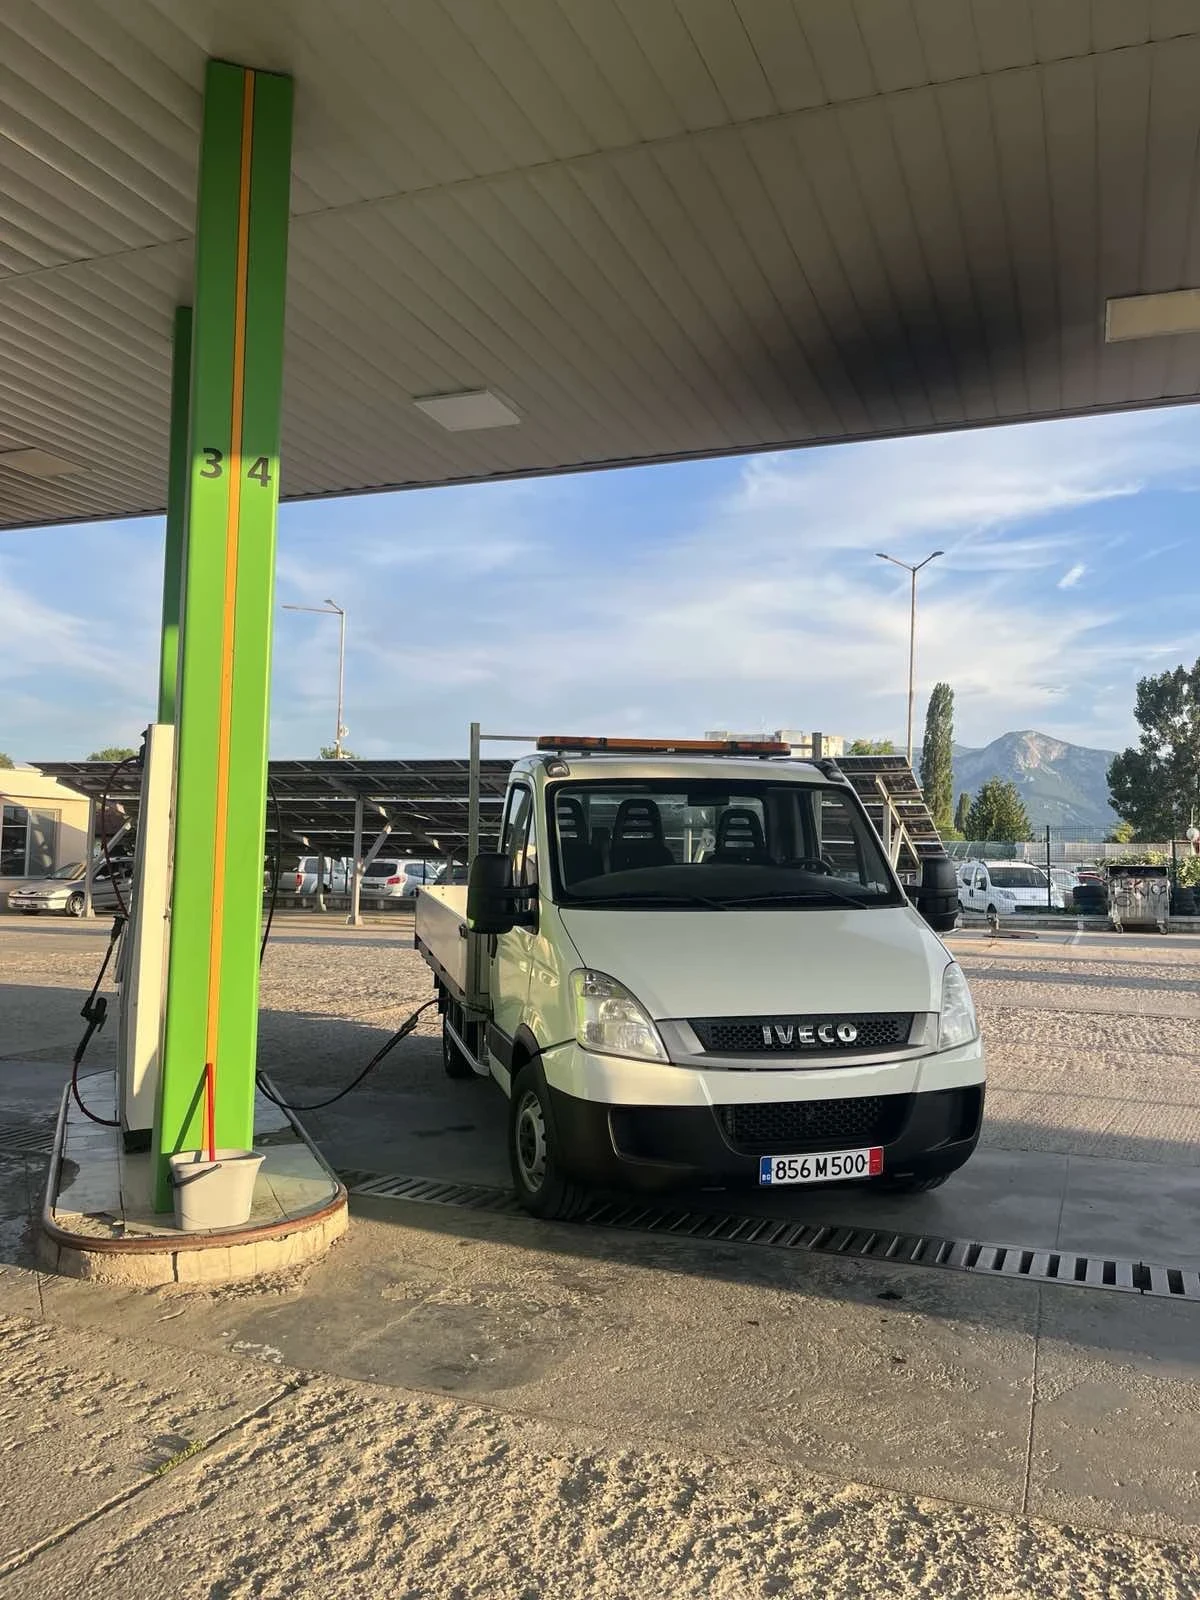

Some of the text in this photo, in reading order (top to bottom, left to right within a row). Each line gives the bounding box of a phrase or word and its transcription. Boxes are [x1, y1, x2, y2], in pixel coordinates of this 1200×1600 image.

[200, 447, 223, 479] 3
[247, 456, 272, 488] 4
[762, 1023, 858, 1045] IVECO
